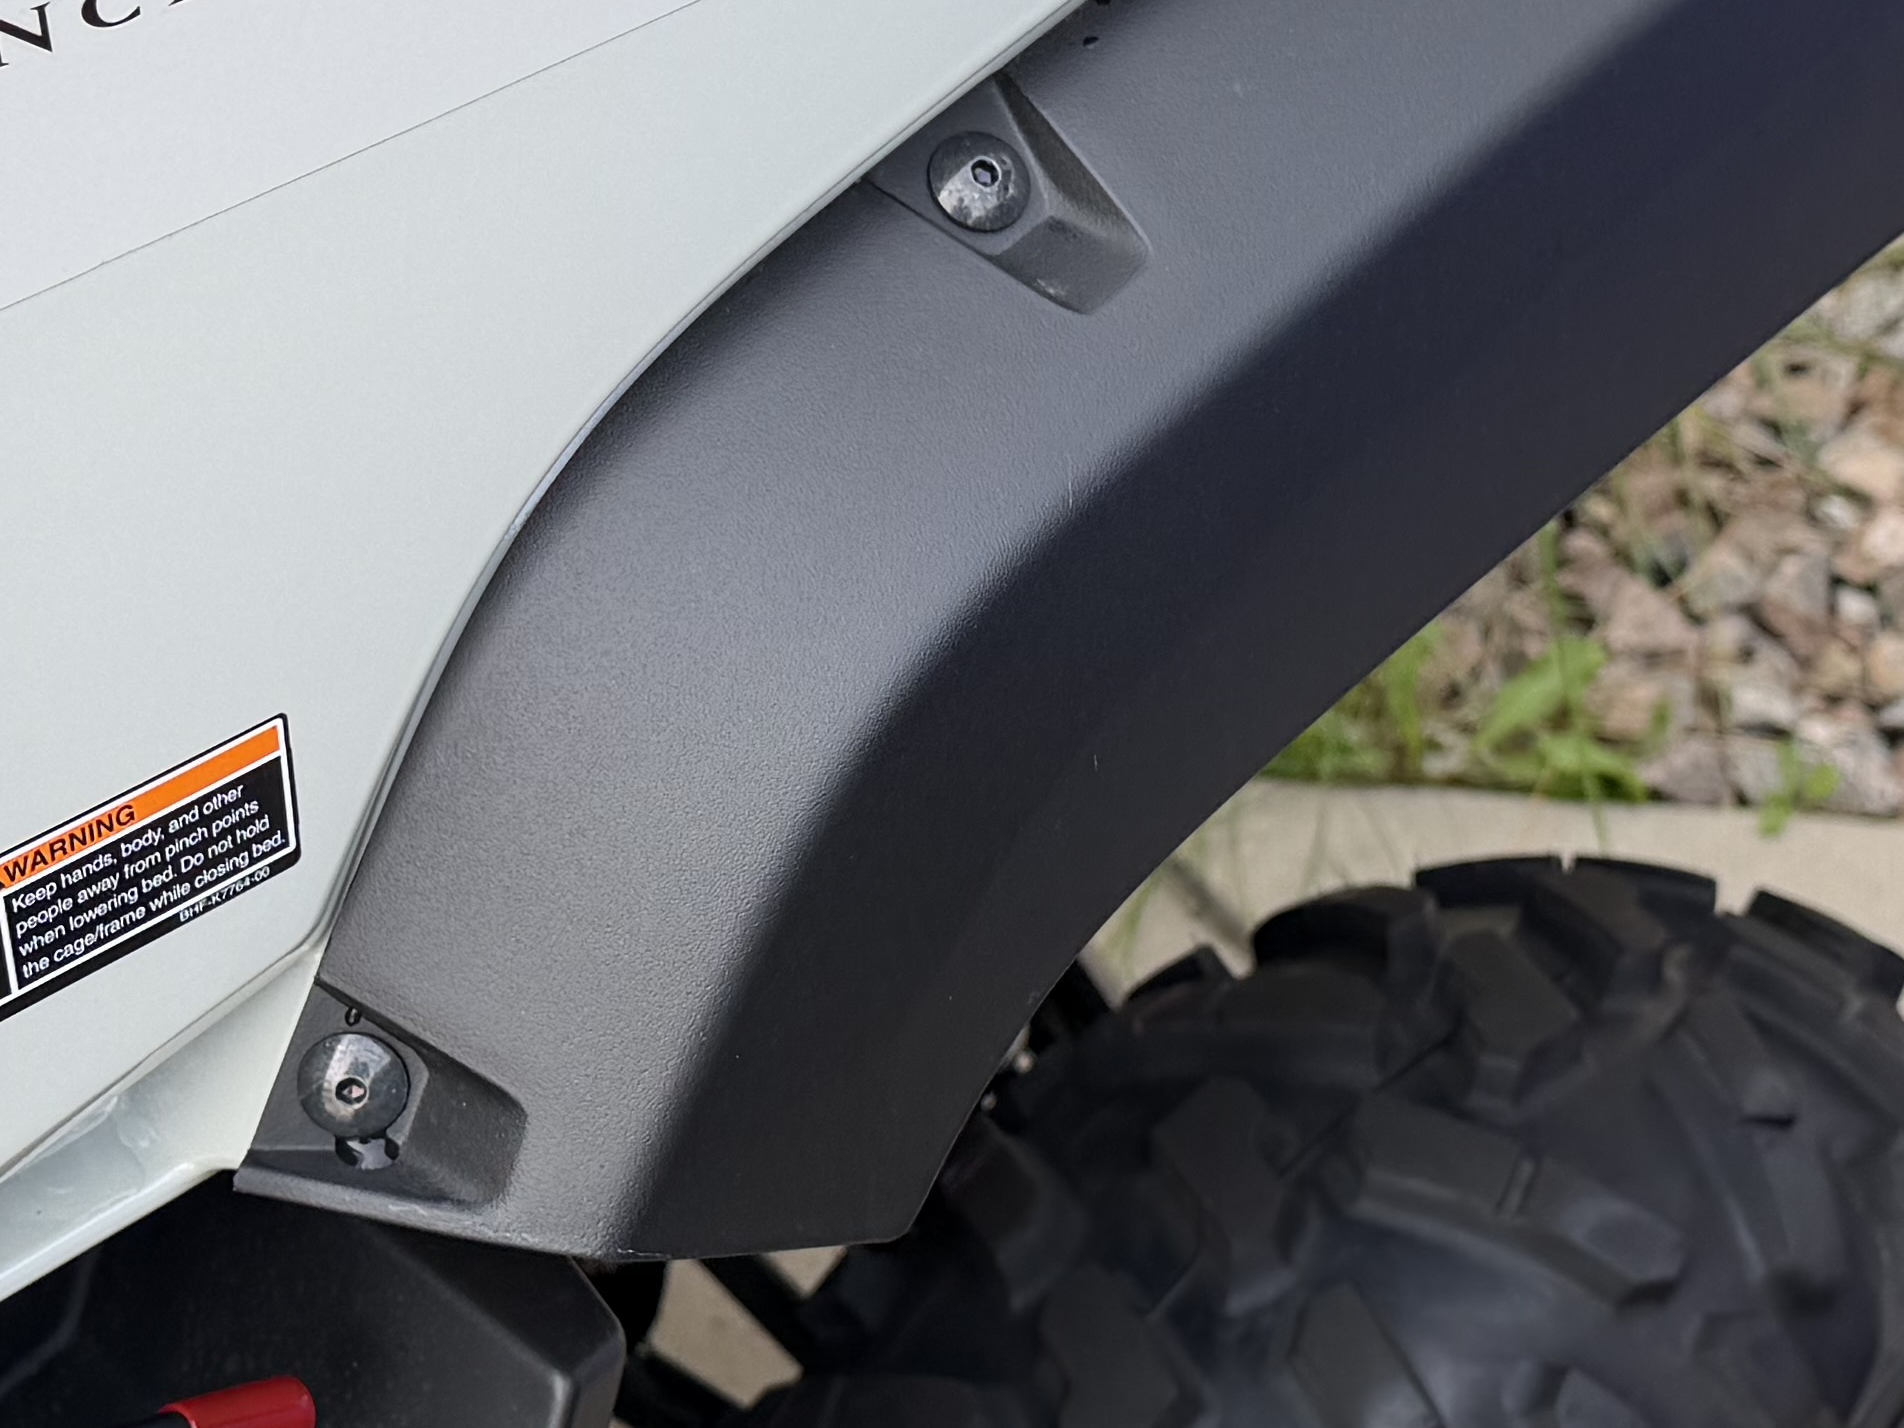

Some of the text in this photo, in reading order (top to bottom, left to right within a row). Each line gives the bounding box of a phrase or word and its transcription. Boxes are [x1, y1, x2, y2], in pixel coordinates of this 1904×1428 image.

[3, 804, 135, 882] WARNING
[11, 784, 244, 913] Keep hands, body, and other
[15, 800, 259, 939] people away from pinch points
[18, 814, 270, 957] when lowering bed. Do not hold
[22, 830, 286, 979] the cage/frame while closing bed.
